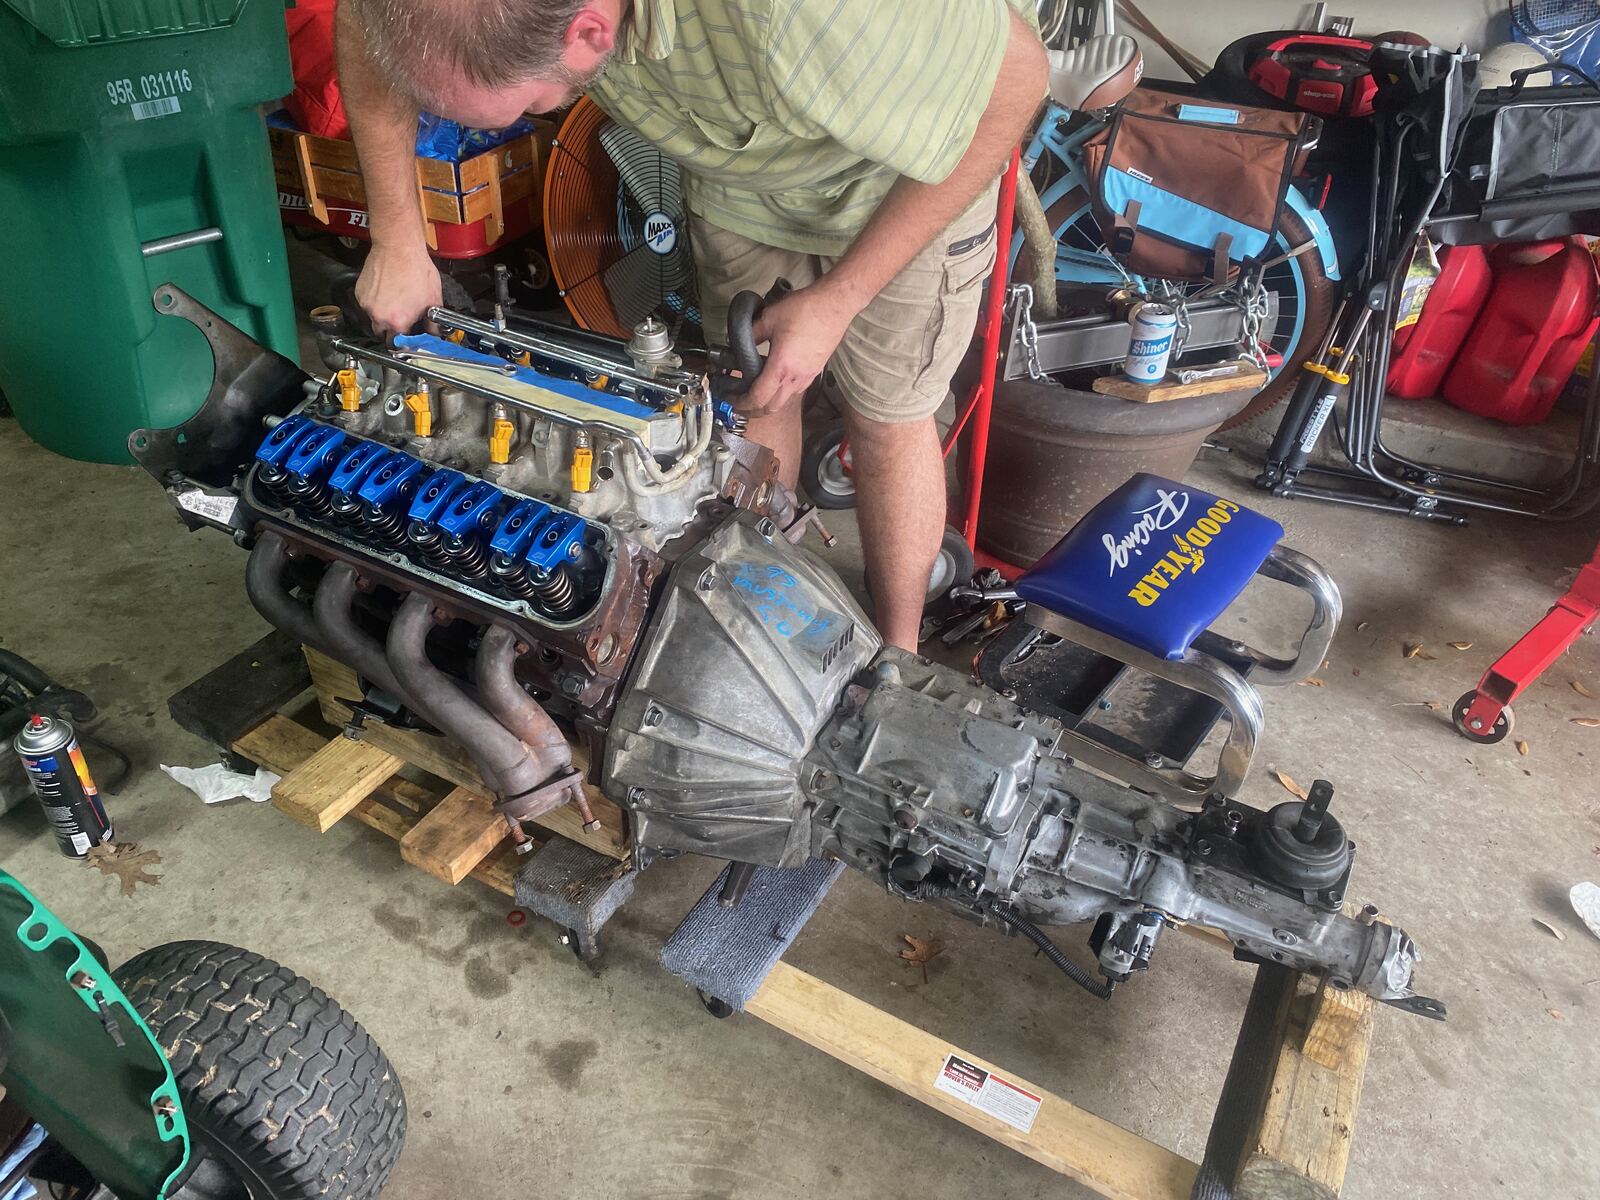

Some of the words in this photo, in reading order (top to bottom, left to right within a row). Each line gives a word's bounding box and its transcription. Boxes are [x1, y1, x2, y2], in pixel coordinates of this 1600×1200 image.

[106, 78, 137, 105] 95R
[140, 68, 193, 99] 031116
[1132, 340, 1169, 356] Shiner
[1299, 397, 1325, 445] FREESTYLE
[1306, 413, 1326, 448] ROCKER
[1322, 402, 1333, 413] XL
[1102, 488, 1190, 578] Racing
